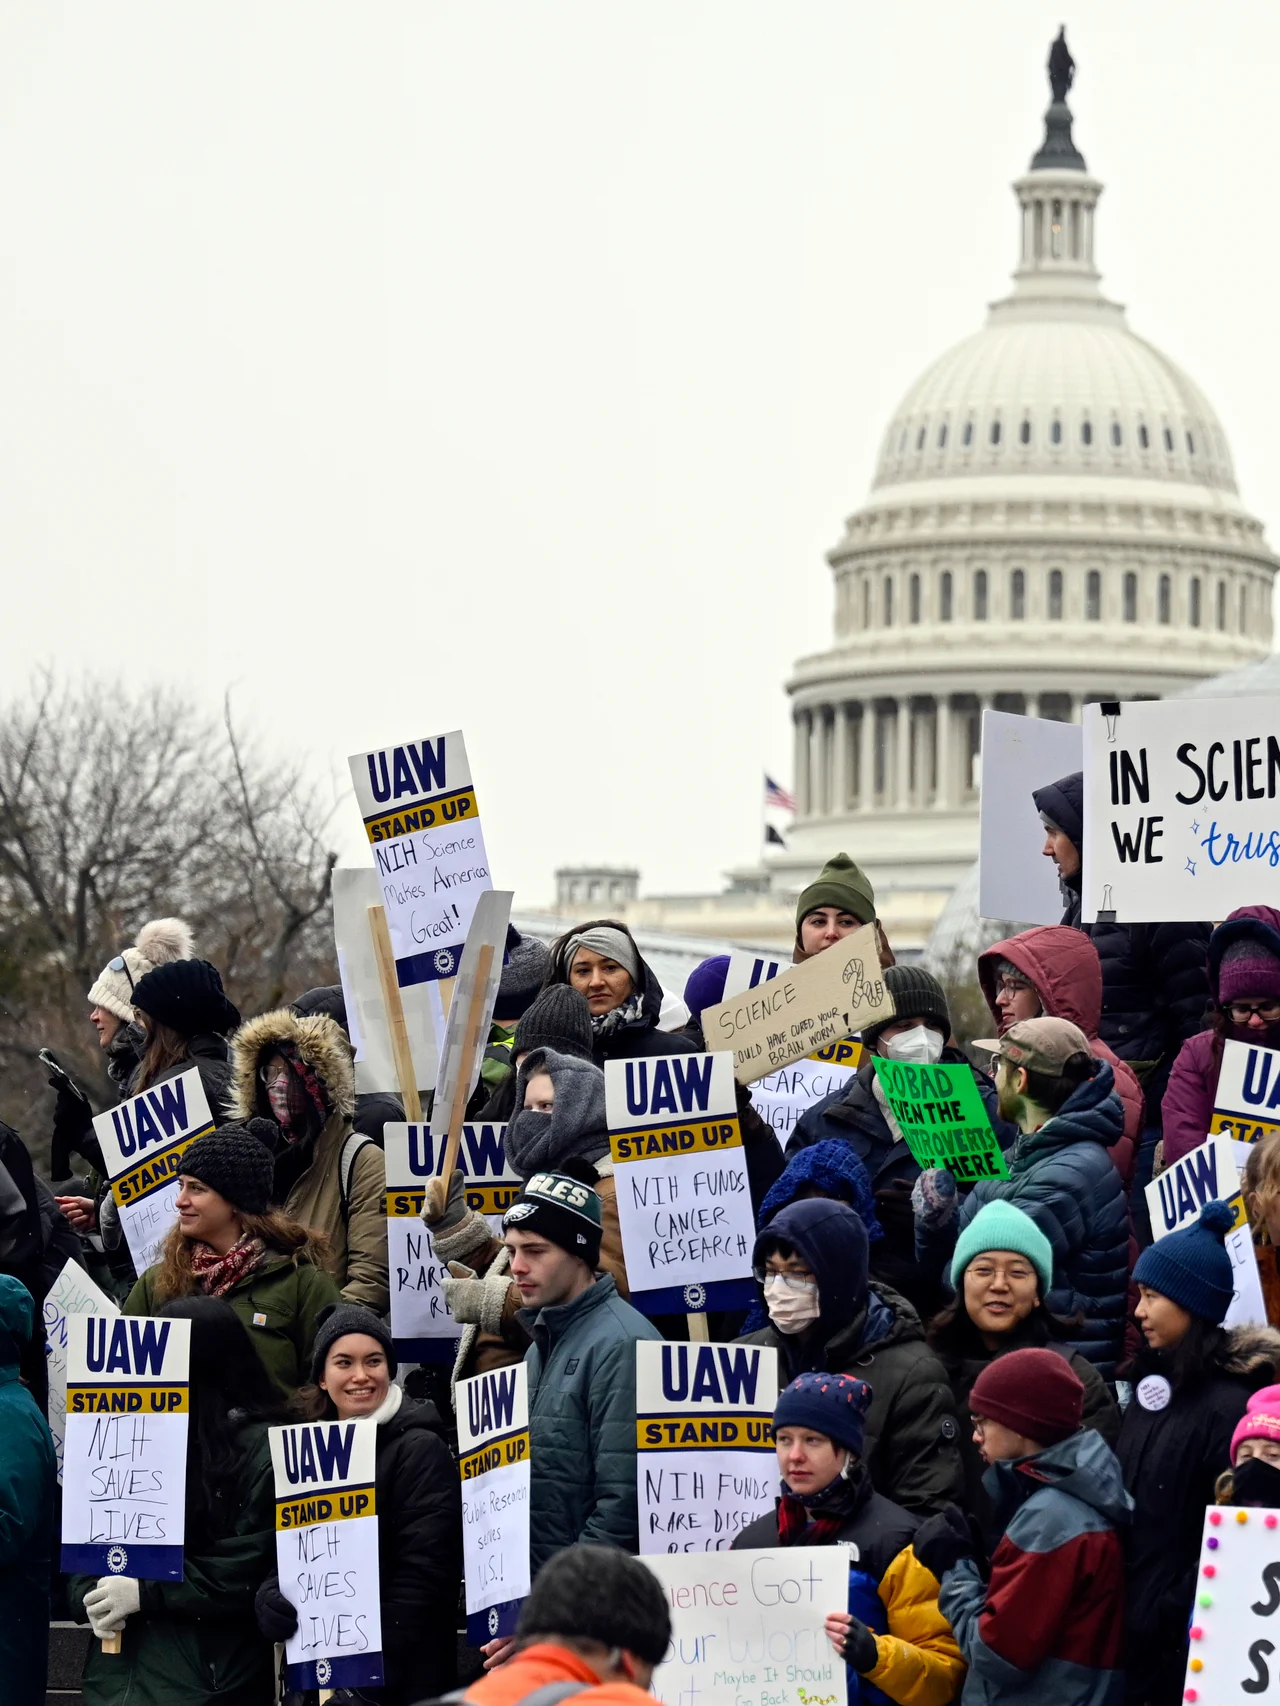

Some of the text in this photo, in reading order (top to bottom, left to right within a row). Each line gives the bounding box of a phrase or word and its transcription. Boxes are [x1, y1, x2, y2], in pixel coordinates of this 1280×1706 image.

[367, 736, 446, 803] UAW
[1109, 747, 1150, 806] IN
[371, 797, 471, 843] STAND UP
[376, 834, 476, 877] NIH Science
[1111, 816, 1164, 864] WE
[383, 865, 489, 910] Makes America
[410, 904, 460, 944] Great!
[718, 982, 797, 1039] SCIENCE
[766, 1031, 787, 1050] HAVE
[790, 1017, 815, 1039] CURED
[818, 1007, 840, 1028] YOUR
[768, 1040, 804, 1066] BRAIN
[808, 1023, 836, 1047] WORM
[817, 1044, 853, 1062] UP
[625, 1056, 713, 1116] UAW
[111, 1077, 189, 1158] UAW
[889, 1097, 966, 1125] EVEN THE
[617, 1124, 733, 1157] STAND UP
[118, 1152, 180, 1200] STAND
[942, 1151, 1001, 1178] HERE
[395, 1193, 484, 1214] STD
[632, 1170, 745, 1209] NIH FUNDS
[1158, 1142, 1218, 1231] UAW
[126, 1203, 160, 1238] THE
[655, 1206, 729, 1240] CANCER
[406, 1233, 432, 1264] NI
[649, 1234, 747, 1269] RESEARCH
[86, 1317, 171, 1376] UAW
[661, 1345, 760, 1405] UAW
[72, 1392, 142, 1413] STAND
[150, 1392, 182, 1411] UP
[468, 1369, 516, 1437] UAW
[88, 1415, 152, 1462] NIH
[646, 1422, 774, 1444] STAND UP
[282, 1424, 356, 1485] UAW
[464, 1440, 526, 1480] STAND UP
[91, 1466, 164, 1498] SAVES
[645, 1469, 768, 1505] NIH FUNDS
[84, 1507, 167, 1544] LIVES
[282, 1494, 369, 1528] STAND UP
[650, 1511, 702, 1534] RARE
[298, 1526, 341, 1564] NIH
[297, 1571, 356, 1603] SAVES
[670, 1557, 823, 1609] ience Got
[300, 1614, 369, 1652] LIVES
[714, 1670, 756, 1693] Maybe
[764, 1667, 779, 1683] It
[786, 1664, 832, 1682] Should
[761, 1690, 789, 1706] Back
